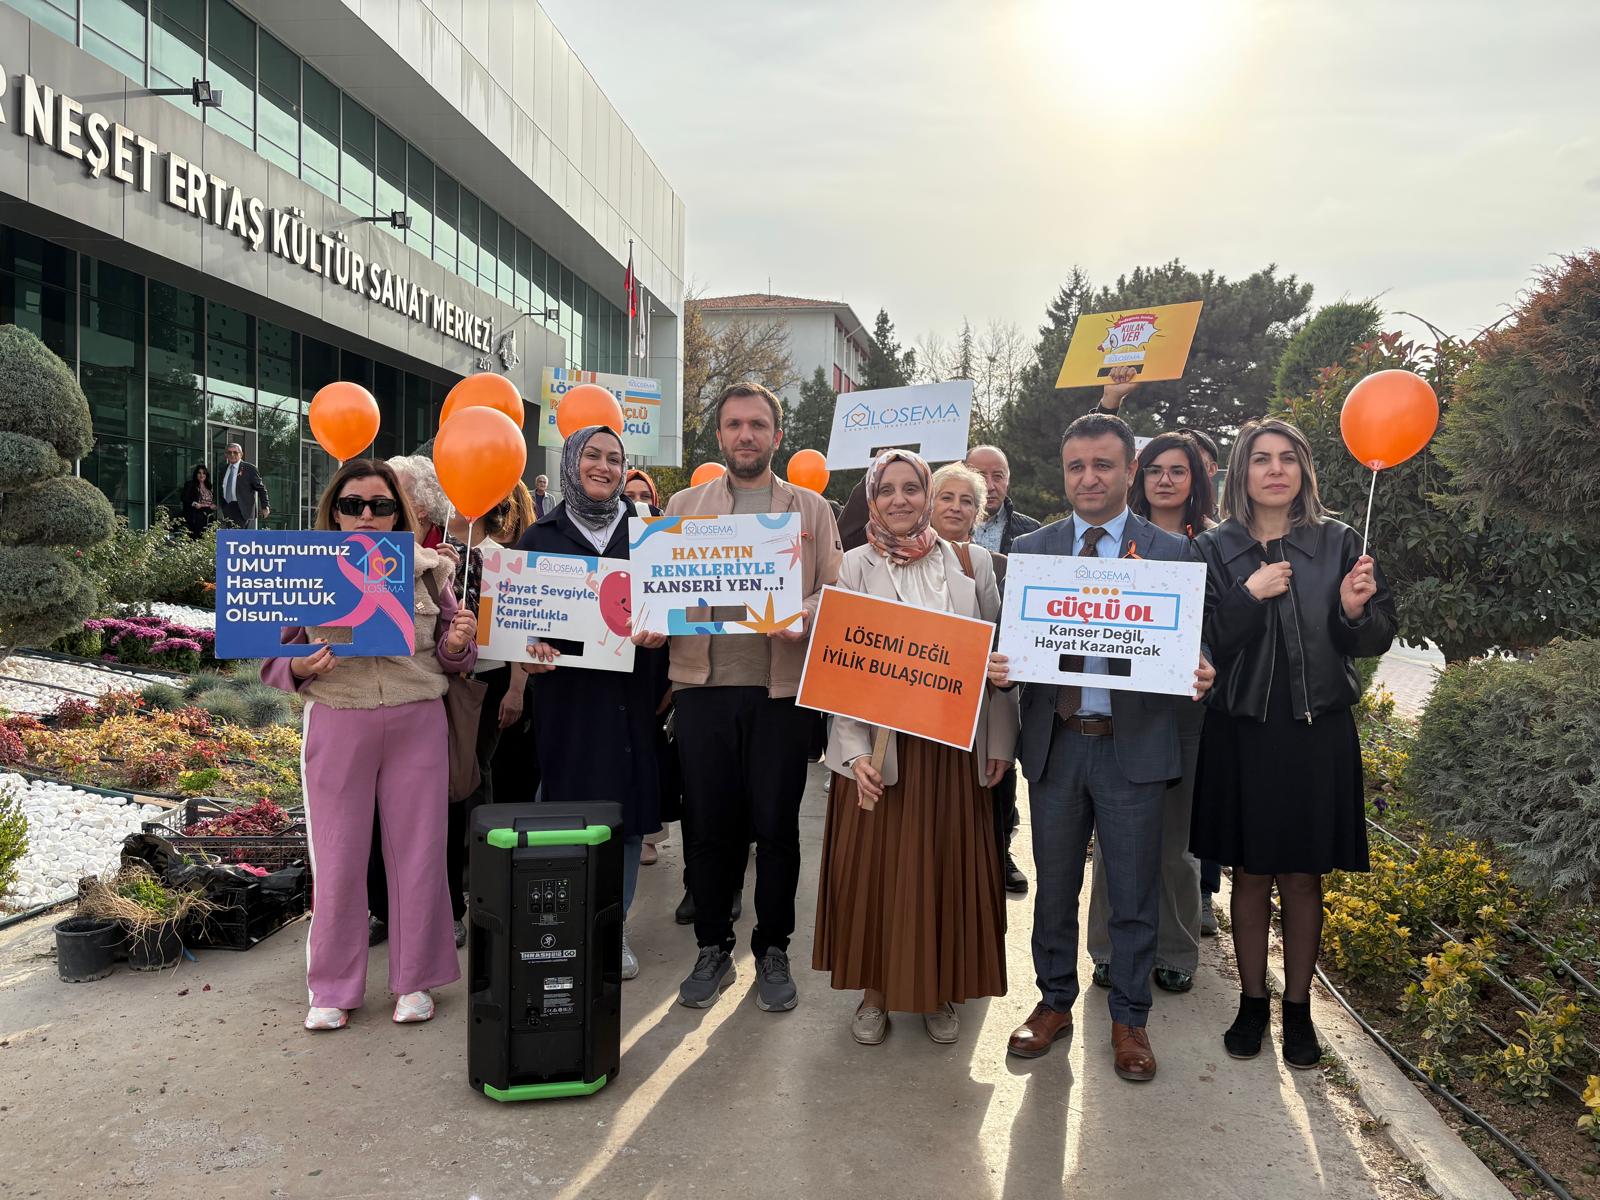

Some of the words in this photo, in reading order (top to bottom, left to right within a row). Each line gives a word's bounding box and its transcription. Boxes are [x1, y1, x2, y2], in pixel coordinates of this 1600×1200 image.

[21, 73, 158, 193] NEŞET
[166, 151, 265, 251] ERTAŞ
[270, 206, 365, 295] KÜLTÜR
[368, 262, 429, 324] SANAT
[431, 293, 495, 355] MERKEZİ
[1121, 323, 1146, 333] KULAK
[1121, 332, 1141, 342] VER
[871, 403, 960, 426] LÖSEMA
[226, 541, 350, 556] Tohumumuz
[672, 545, 754, 561] HAYATIN
[226, 558, 287, 573] UMUT
[651, 558, 776, 578] RENKLERİYLE
[226, 575, 324, 589] Hasatımız
[643, 575, 722, 594] KANSERİ
[726, 577, 784, 592] YEN...!
[226, 592, 336, 606] MUTLULUK
[499, 581, 537, 595] Hayat
[541, 584, 599, 601] Sevgiyle,
[498, 593, 543, 607] Kanser
[225, 608, 298, 622] Olsun...
[496, 605, 569, 621] Kararlılıkla
[1046, 596, 1121, 624] GÜÇLÜ
[1124, 604, 1154, 623] OL
[1049, 624, 1101, 638] Kanser
[1102, 628, 1145, 644] Değil,
[844, 626, 905, 654] LÖSEMİ
[907, 642, 951, 666] DEĞİL
[1034, 636, 1077, 652] Hayat
[1080, 640, 1161, 656] Kazanacak
[822, 645, 866, 671] İYİLİK
[868, 659, 963, 695] BULAŞICIDIR
